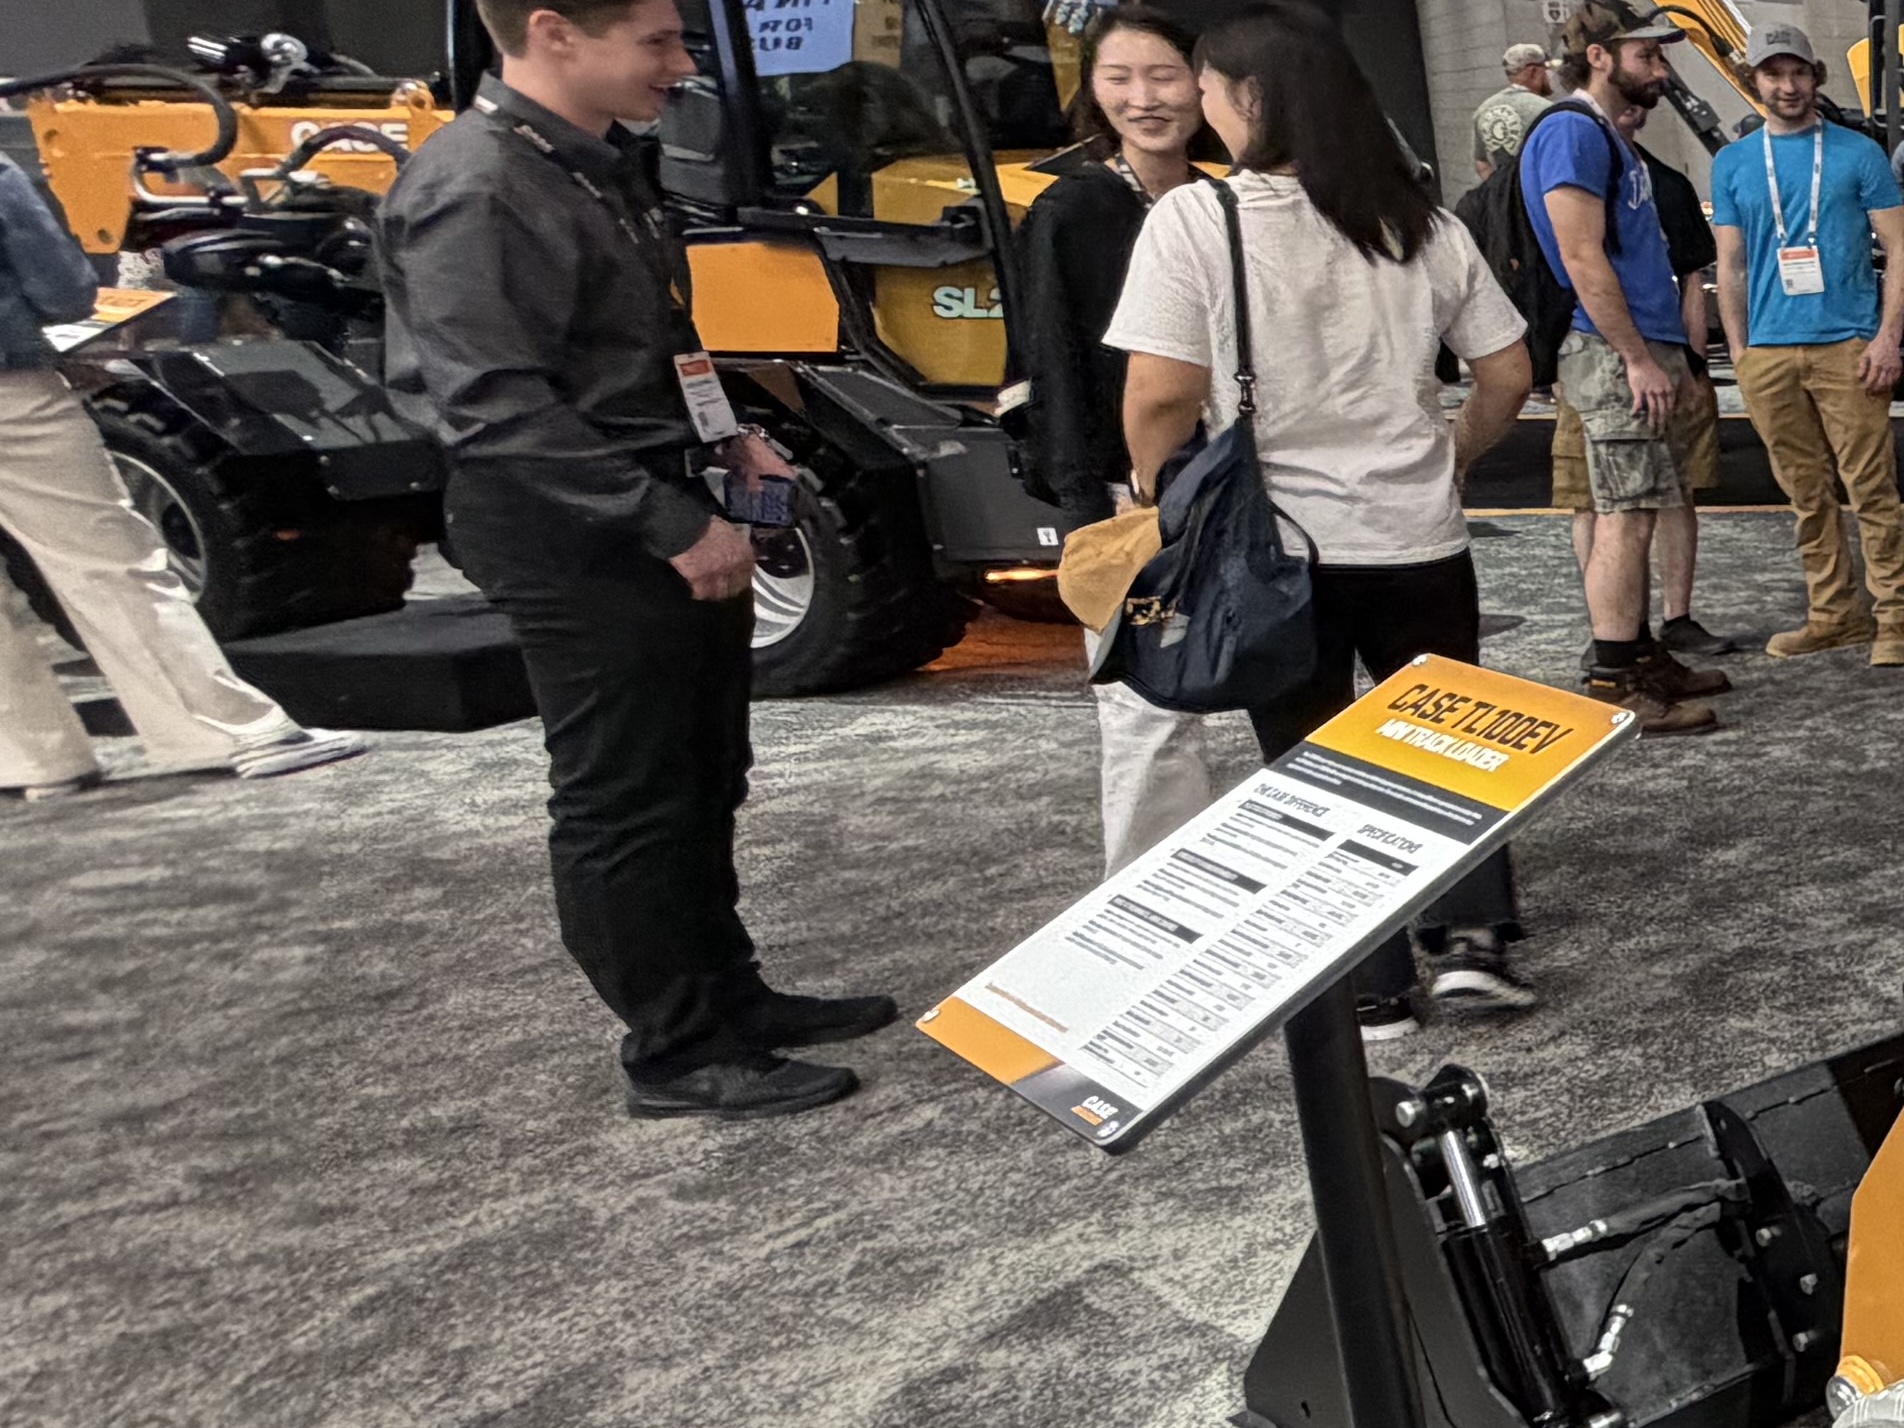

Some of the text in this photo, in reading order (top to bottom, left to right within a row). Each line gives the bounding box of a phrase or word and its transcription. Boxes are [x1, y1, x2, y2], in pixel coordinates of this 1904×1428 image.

[932, 285, 1006, 319] SL2
[1387, 683, 1574, 755] CASE TL100EV
